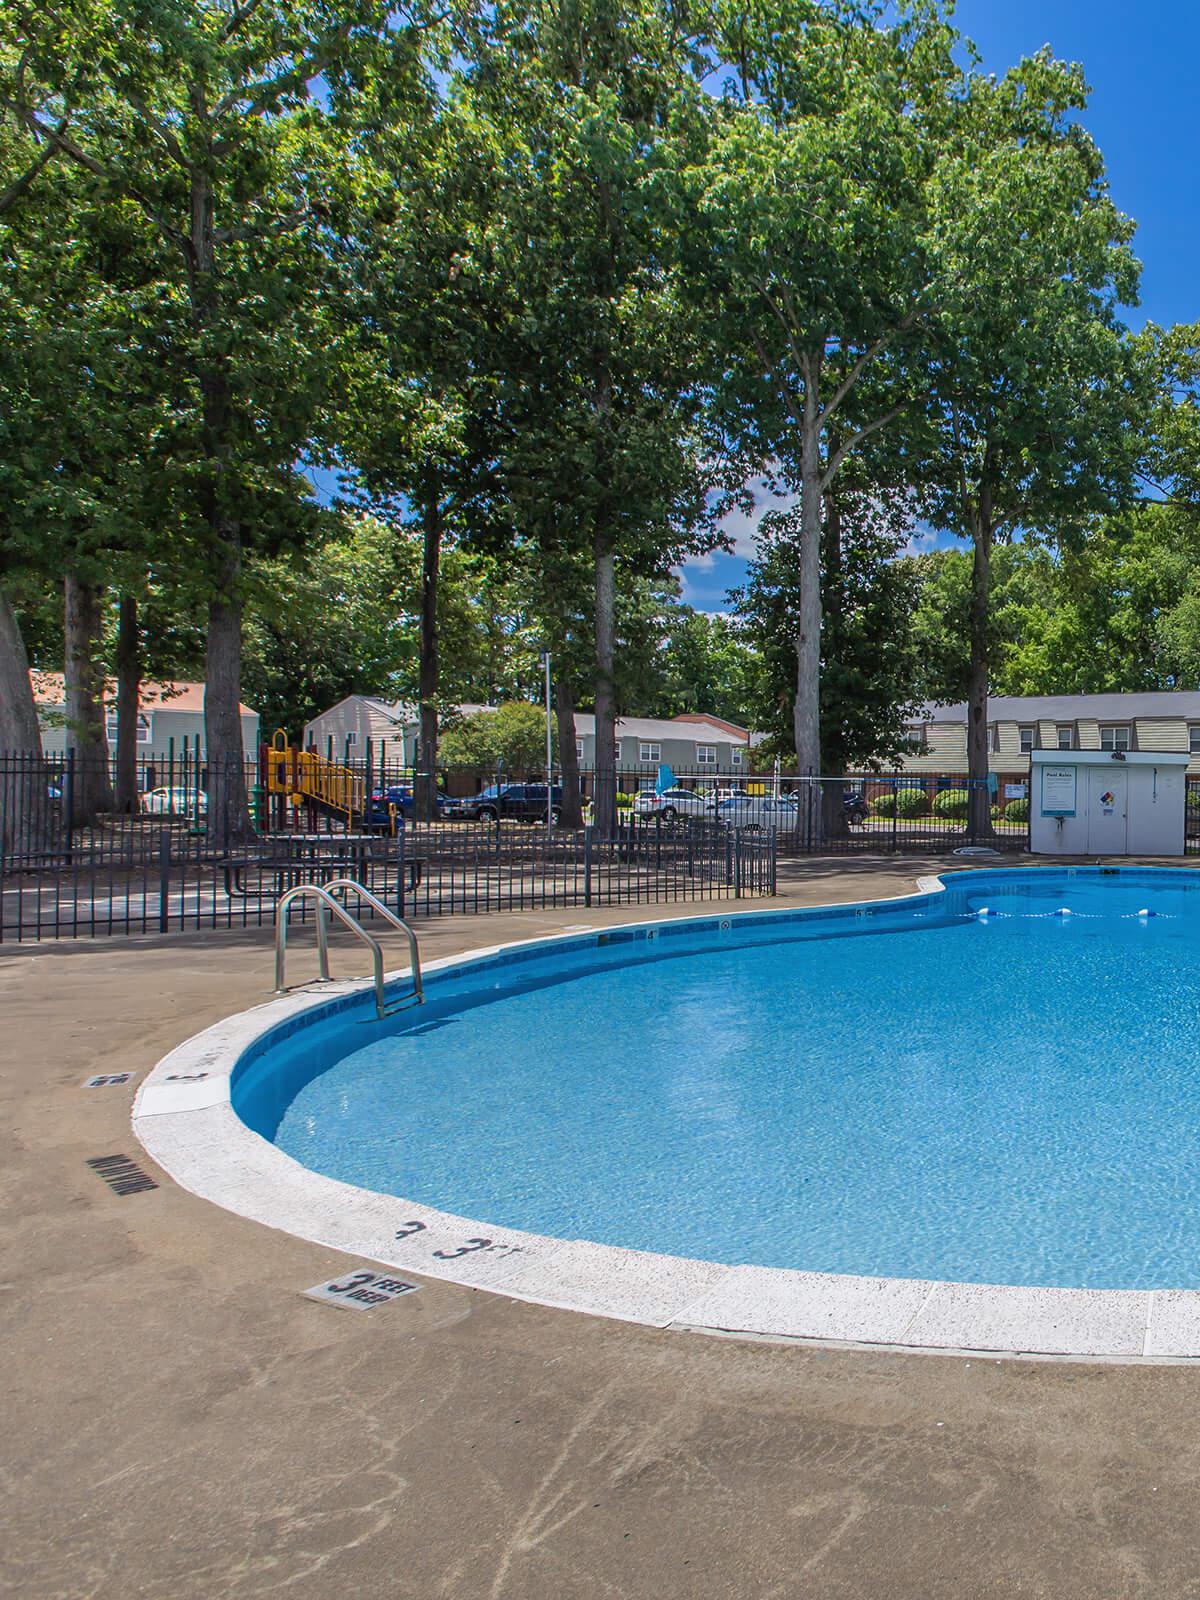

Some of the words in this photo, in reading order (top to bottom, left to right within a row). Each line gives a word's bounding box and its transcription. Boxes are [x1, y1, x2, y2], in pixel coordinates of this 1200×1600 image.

[432, 1238, 492, 1259] 3
[328, 1274, 375, 1292] 3
[371, 1279, 416, 1294] FEET
[346, 1289, 391, 1304] DEEP
